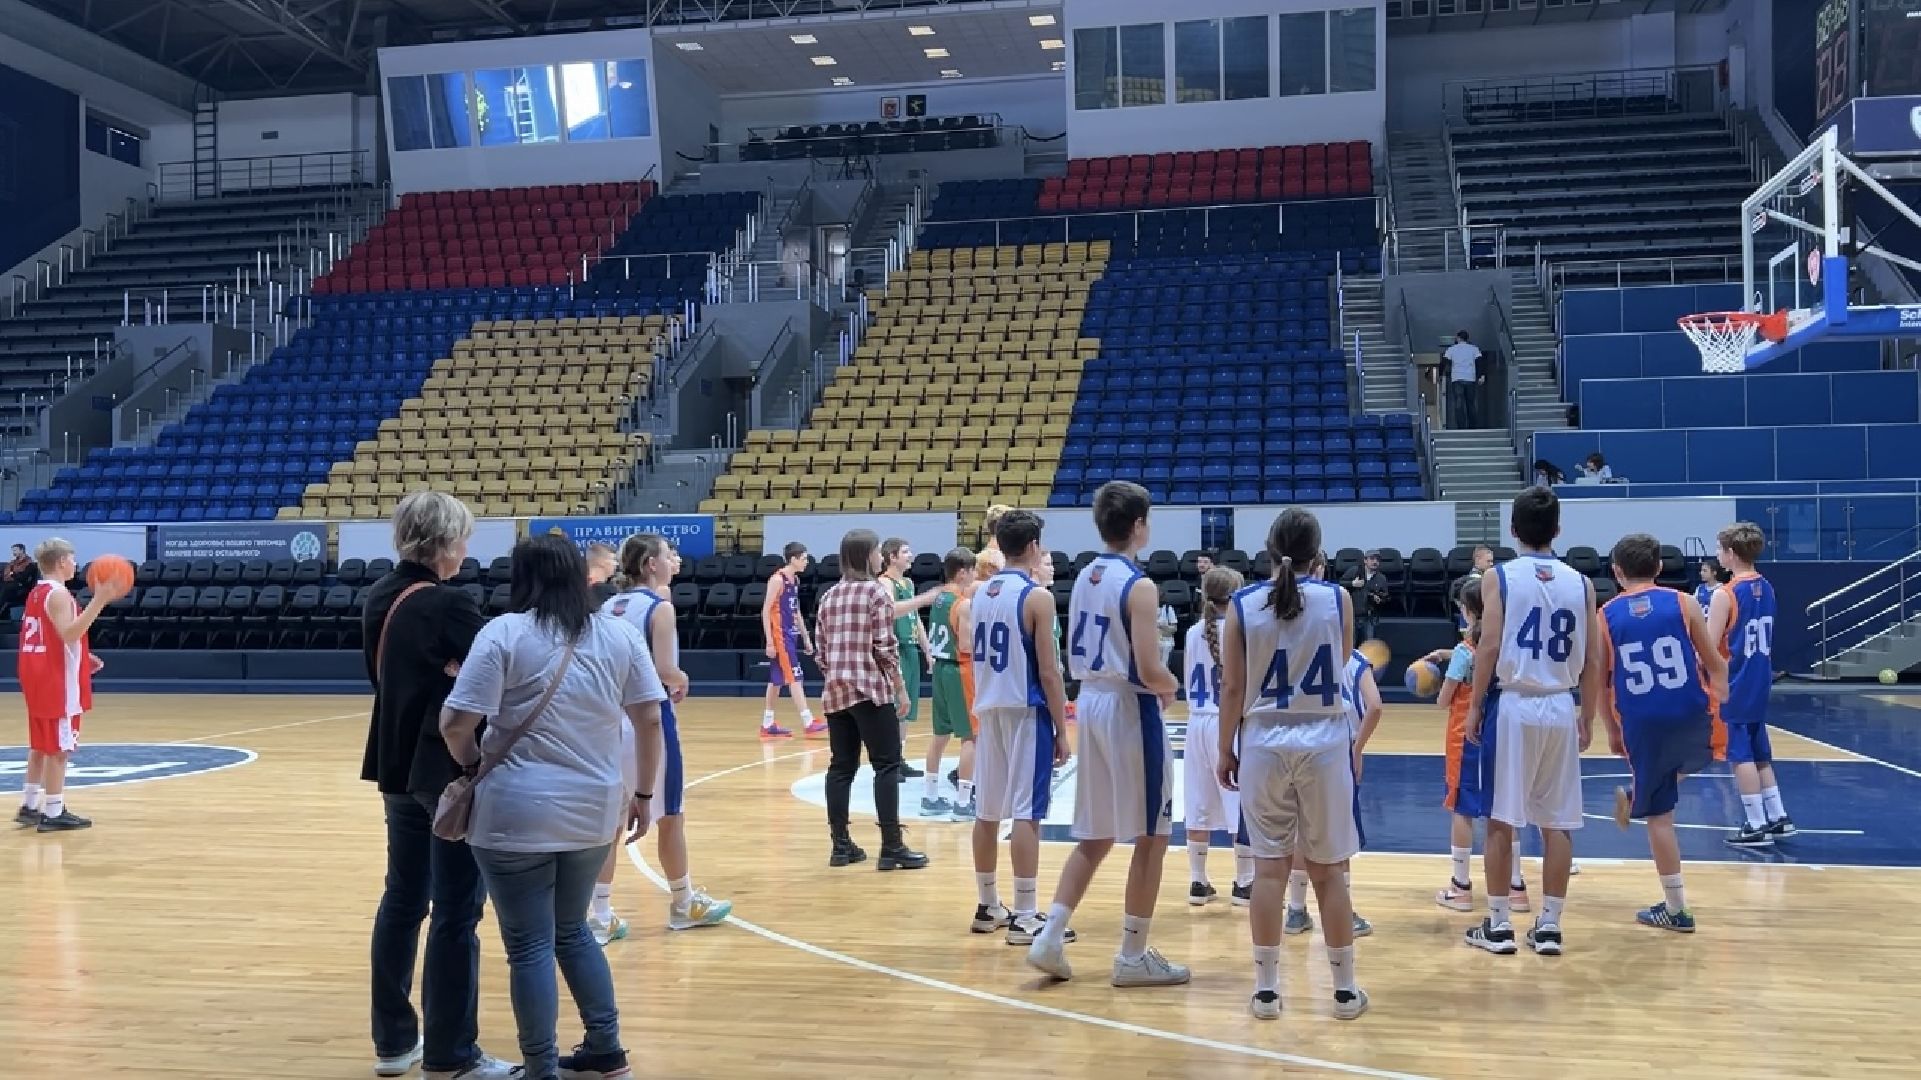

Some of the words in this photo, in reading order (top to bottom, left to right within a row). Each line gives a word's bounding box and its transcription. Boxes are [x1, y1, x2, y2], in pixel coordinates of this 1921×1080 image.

[575, 524, 700, 538] ПРАВИТЕЛЬСТВО
[22, 616, 47, 652] 21
[974, 621, 1010, 673] 49
[1516, 607, 1576, 662] 48
[1261, 643, 1340, 710] 44
[1618, 635, 1689, 695] 59
